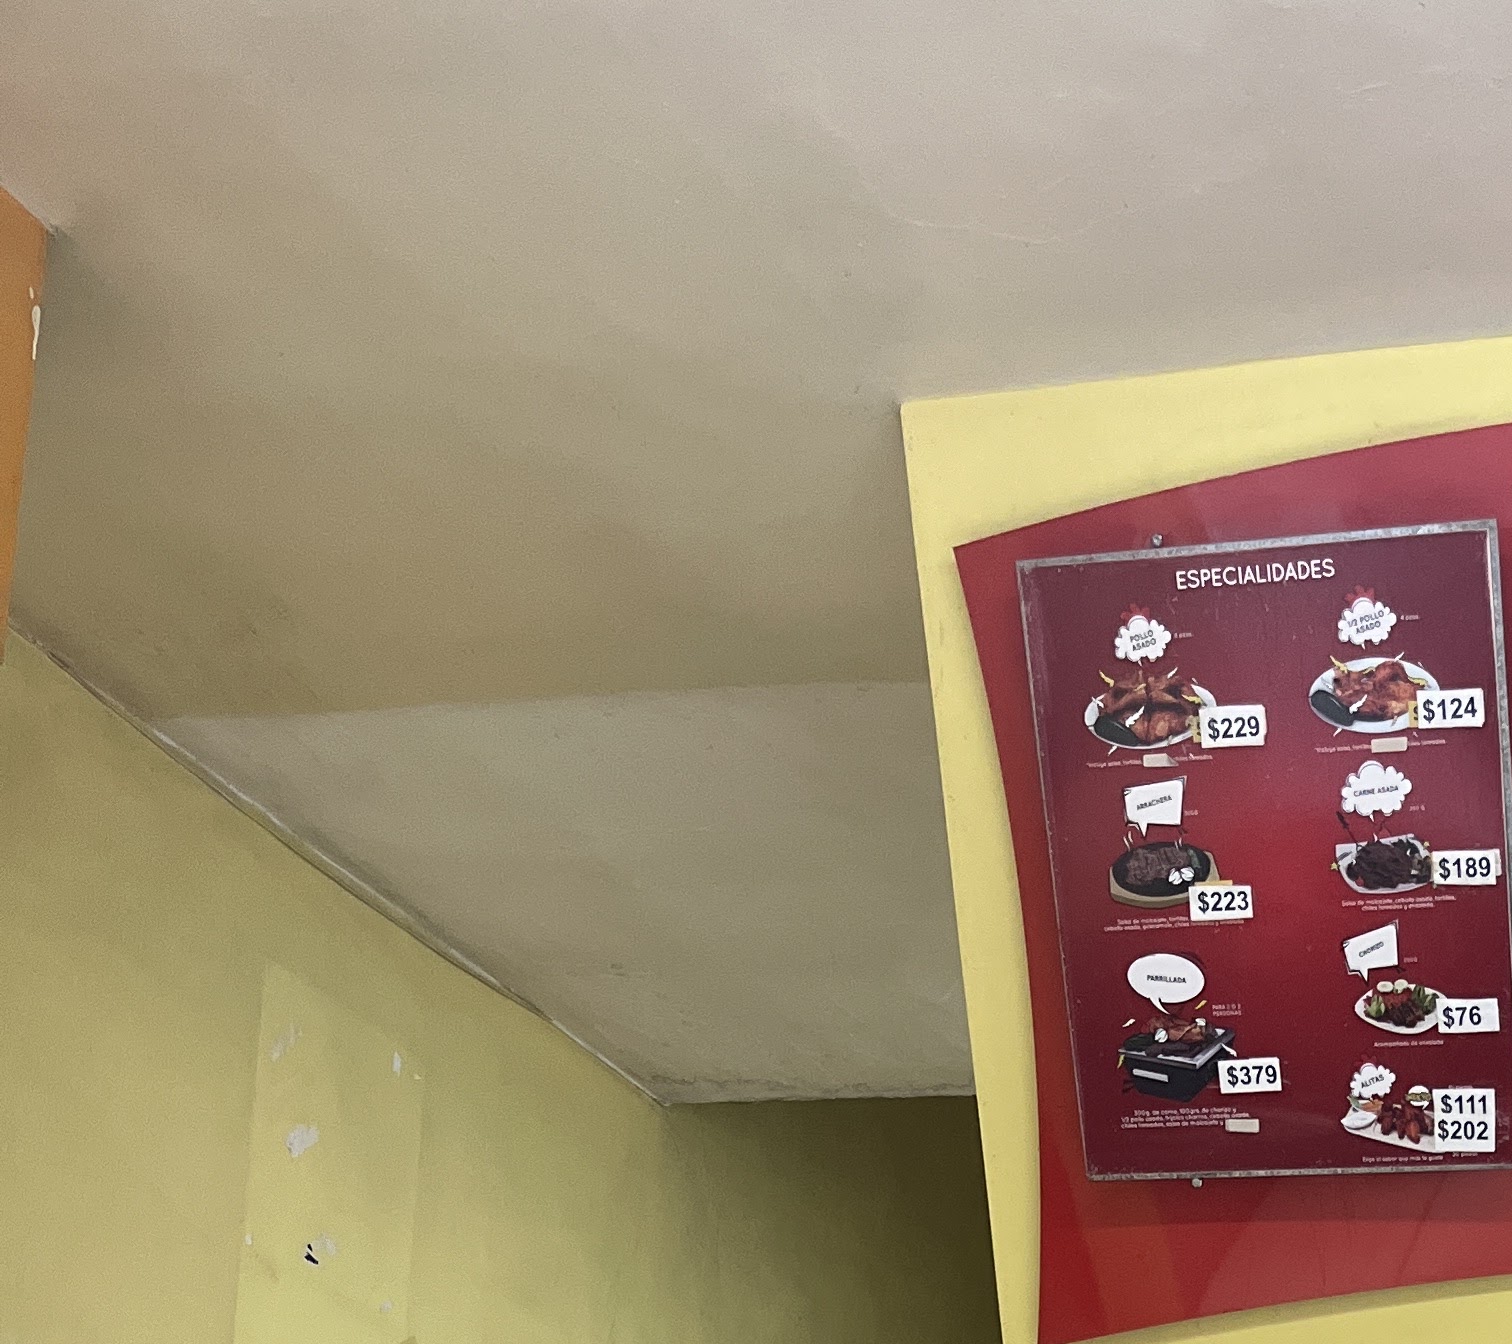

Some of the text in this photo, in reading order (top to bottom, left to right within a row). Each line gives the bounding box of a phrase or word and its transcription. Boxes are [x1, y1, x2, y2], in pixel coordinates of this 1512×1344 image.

[1175, 558, 1336, 590] ESPECIALIDADES
[1422, 696, 1478, 723] $124
[1207, 716, 1260, 742] $229
[1438, 856, 1491, 881] $189
[1197, 890, 1249, 914] $223
[1442, 1005, 1482, 1029] $76
[1226, 1064, 1278, 1088] $379
[1360, 1074, 1385, 1090] ALITAS
[1441, 1094, 1488, 1115] $111
[1437, 1119, 1489, 1142] $202
